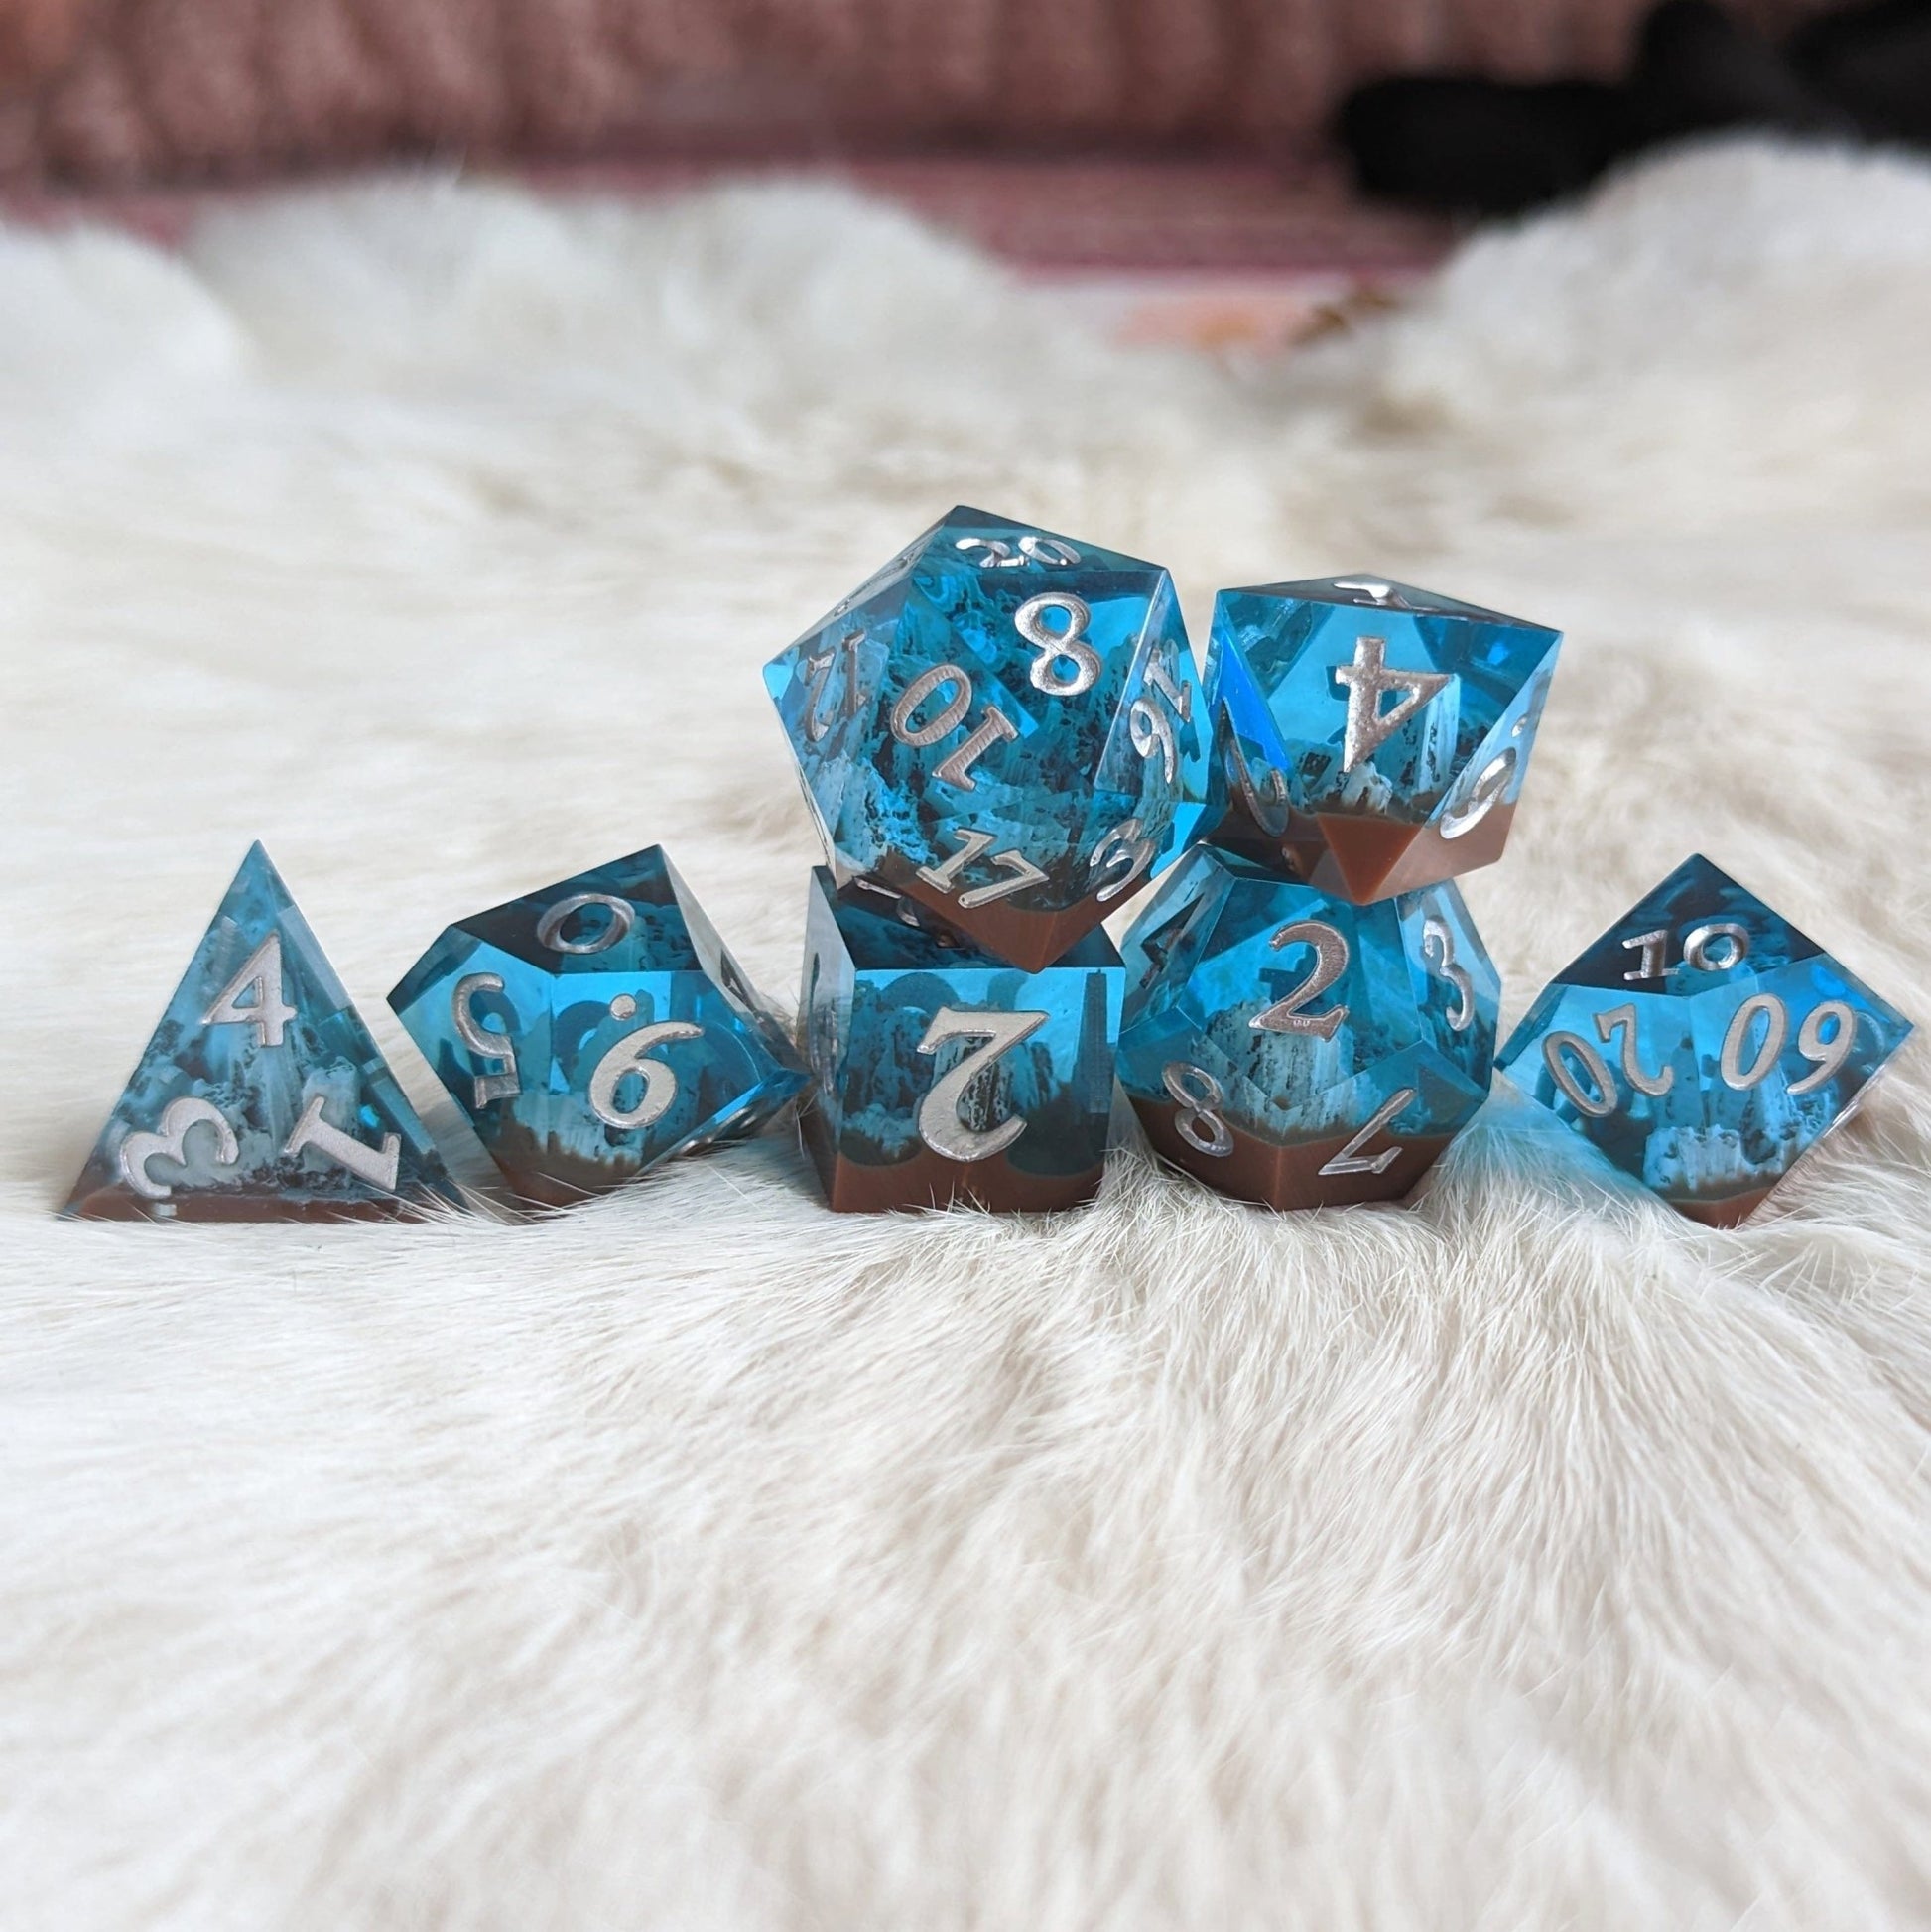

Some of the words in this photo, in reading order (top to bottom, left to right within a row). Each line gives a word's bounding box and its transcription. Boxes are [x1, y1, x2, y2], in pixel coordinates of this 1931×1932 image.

[956, 536, 1082, 569] 20
[1014, 592, 1103, 697] 8
[893, 663, 1019, 792] 10
[1334, 636, 1457, 773] 4
[915, 827, 1050, 909] 17
[1090, 817, 1157, 903] 3
[202, 929, 298, 1049] 4
[1247, 919, 1351, 1043] 2
[1422, 915, 1475, 1032] 3
[1622, 923, 1751, 981] 10
[451, 971, 523, 1110] 5
[916, 1005, 1051, 1162] 2
[120, 1096, 240, 1199] 3
[284, 1095, 402, 1192] 1
[1162, 1060, 1234, 1158] 8
